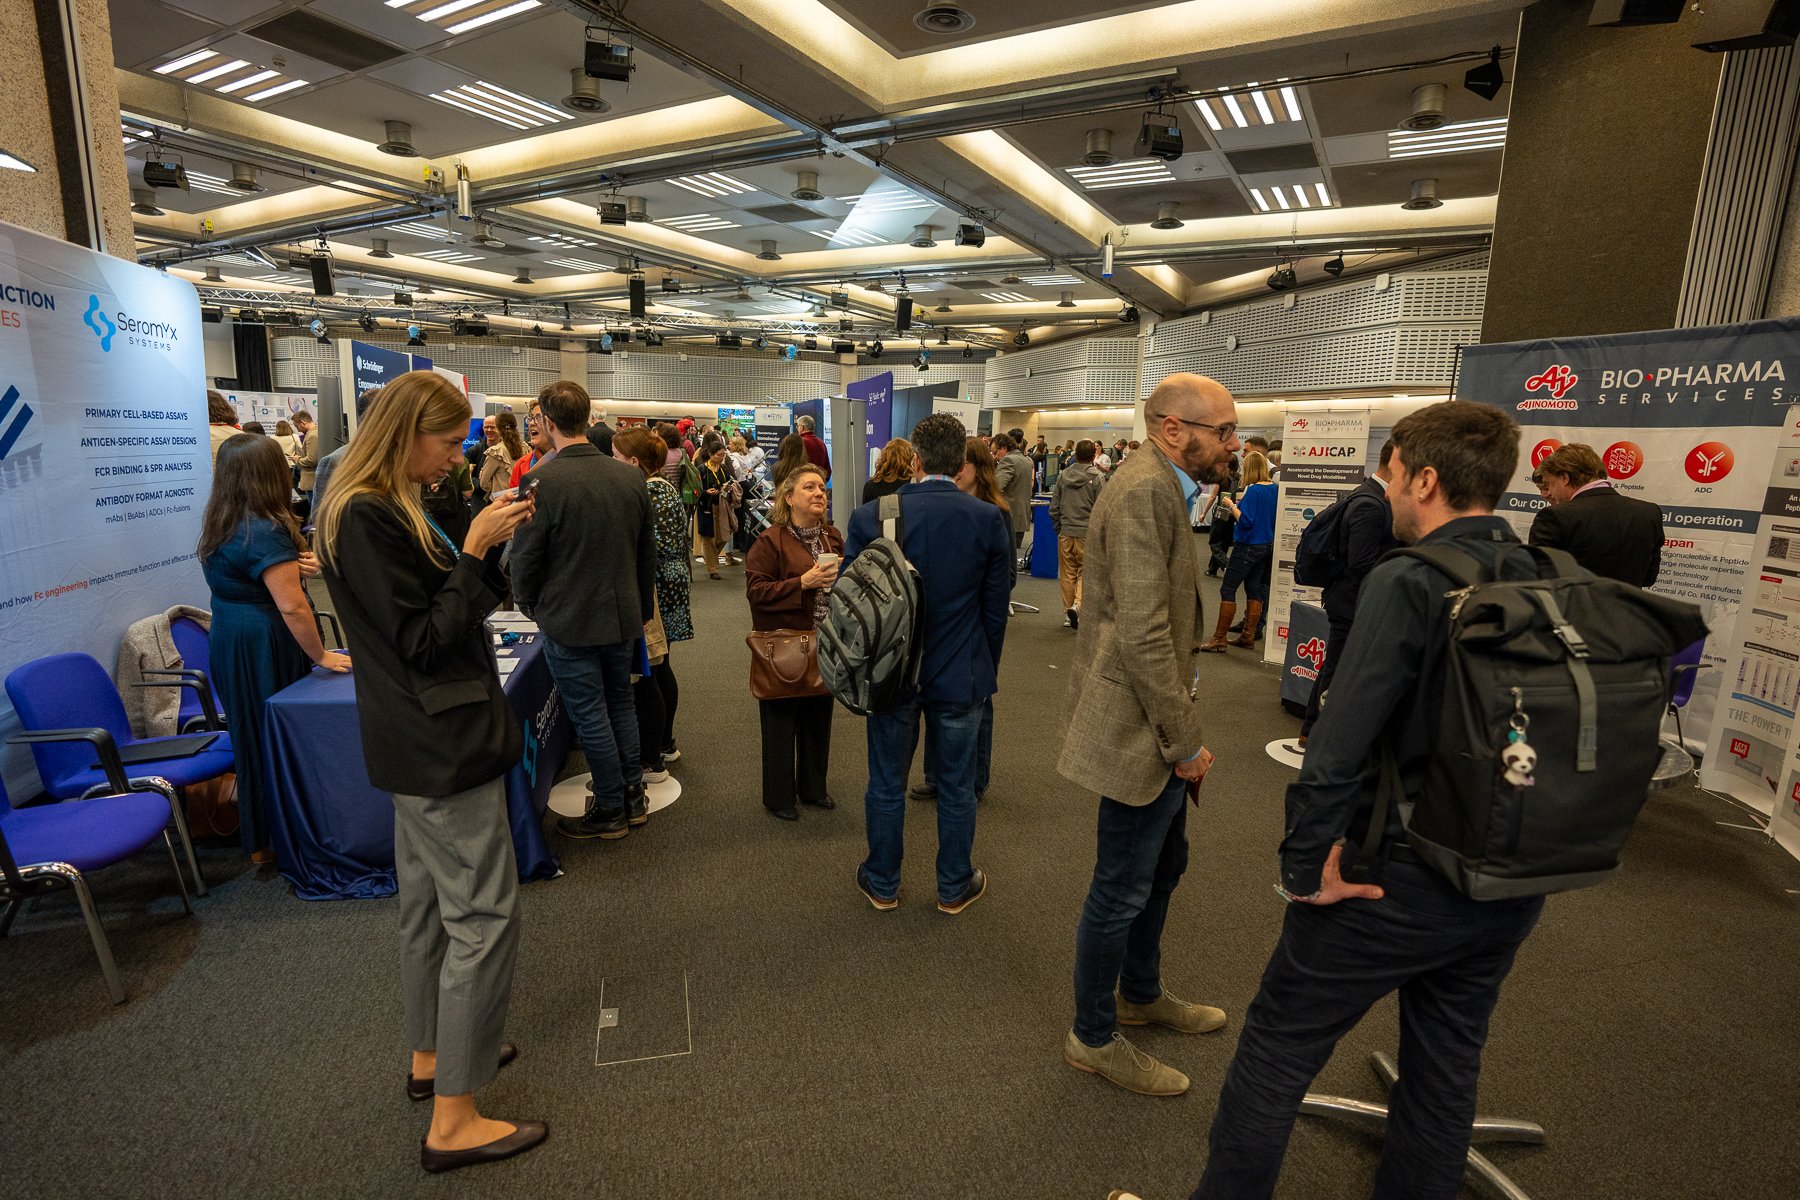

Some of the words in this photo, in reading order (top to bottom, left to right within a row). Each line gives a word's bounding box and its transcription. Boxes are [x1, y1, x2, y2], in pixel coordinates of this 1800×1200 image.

[128, 336, 171, 351] SYSTEMS
[1598, 387, 1783, 405] SERVICES
[85, 408, 121, 418] PRIMARY
[122, 409, 164, 420] CELL-BASED
[165, 411, 188, 420] ASSAYS
[80, 437, 149, 447] ANTIGEN-SPECIFIC
[150, 437, 170, 446] ASSAY
[171, 436, 197, 446] DESIGNS
[1308, 446, 1356, 457] AJICAP
[95, 466, 111, 477] FCR
[112, 464, 143, 476] BINDING
[144, 464, 149, 473] &
[150, 463, 163, 473] SPR
[164, 462, 192, 471] ANALYSIS
[1620, 483, 1645, 491] Peptide
[95, 494, 134, 507] ANTIBODY
[135, 490, 163, 502] FORMAT
[164, 487, 194, 498] AGNOSTIC
[1509, 497, 1527, 508] Our
[1788, 494, 1798, 502] An
[105, 512, 123, 524] mAbs
[127, 510, 145, 521] BsAbs
[149, 507, 163, 517] ADCs
[166, 503, 191, 515] Fc-fusions
[1674, 514, 1744, 528] operation
[1719, 556, 1750, 566] Peptide
[1673, 570, 1710, 582] technology
[1679, 562, 1708, 570] molecule
[1709, 566, 1745, 576] expertise
[15, 594, 33, 606] how
[34, 591, 44, 600] Fc
[45, 580, 88, 598] engineering
[89, 572, 114, 586] impacts
[114, 567, 138, 580] immune
[139, 560, 160, 573] function
[161, 558, 171, 567] and
[171, 554, 189, 565] effector
[1674, 580, 1703, 590] molecule
[1651, 586, 1676, 595] Central
[1677, 588, 1687, 597] Aji
[1687, 590, 1698, 598] Co.
[1700, 592, 1717, 600] R&D
[1728, 707, 1750, 723] THE
[1752, 714, 1782, 737] POWER
